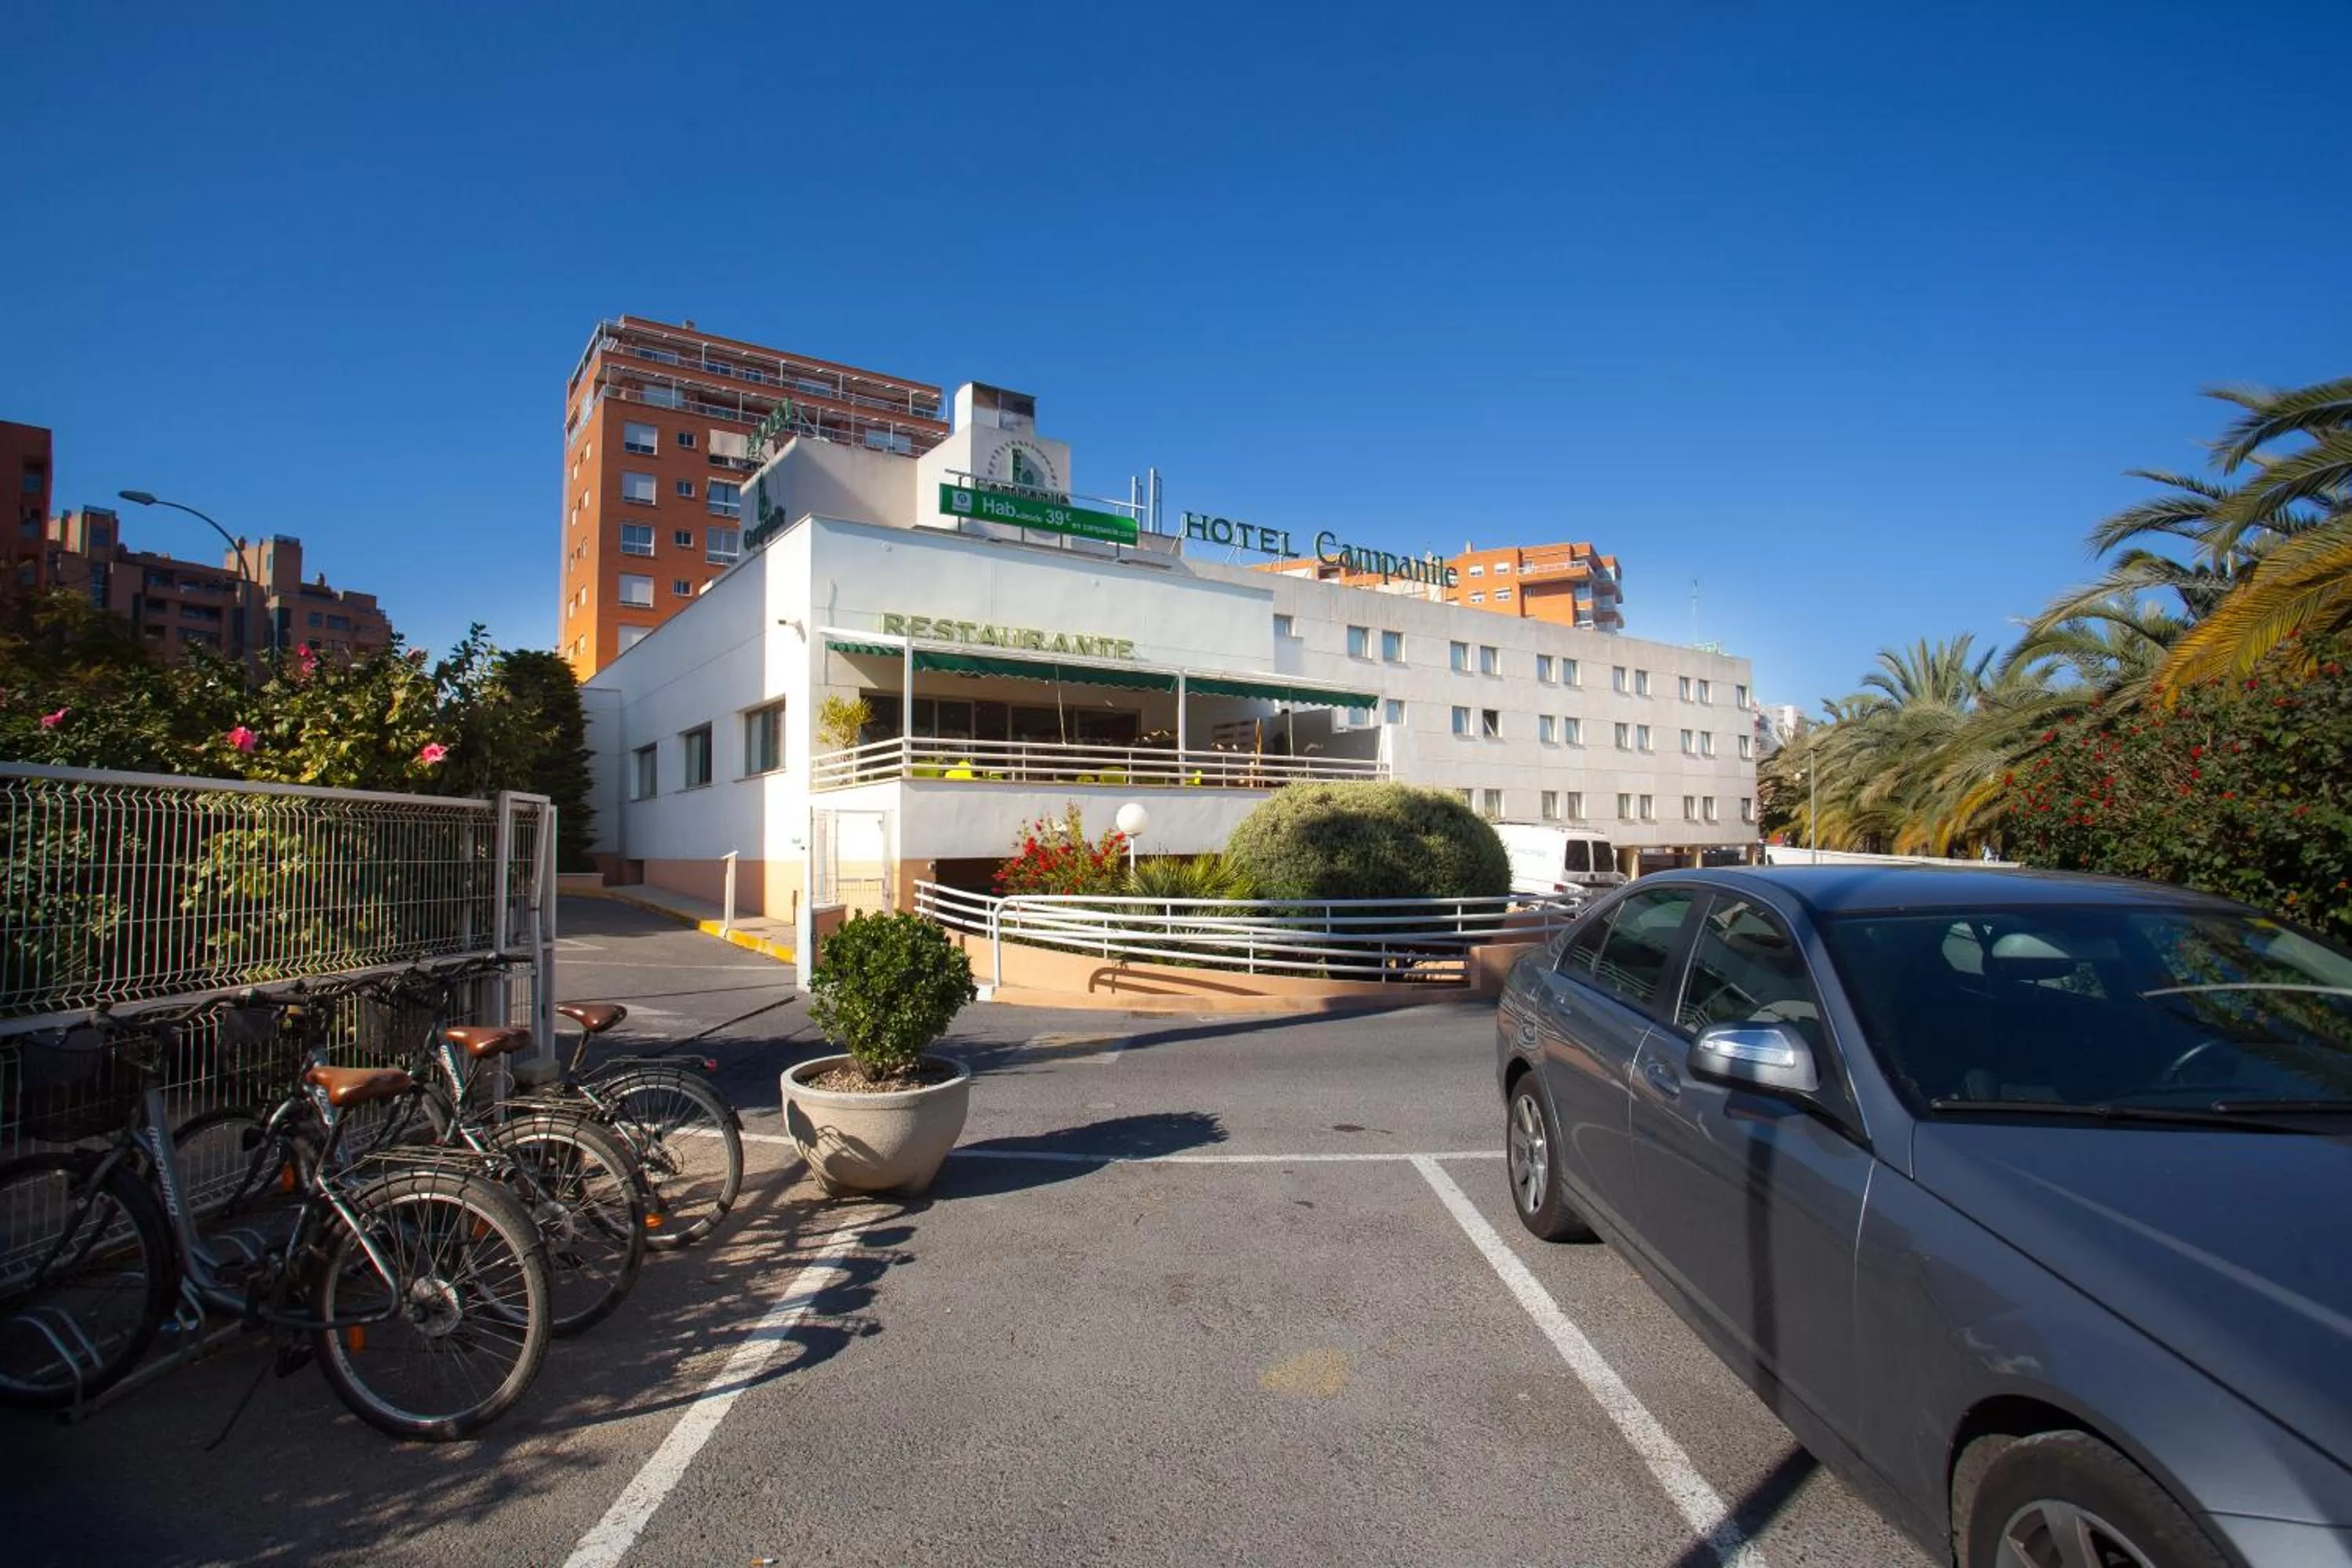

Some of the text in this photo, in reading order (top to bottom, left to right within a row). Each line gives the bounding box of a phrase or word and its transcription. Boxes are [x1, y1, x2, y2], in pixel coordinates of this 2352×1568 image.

[1183, 510, 1459, 589] HOTEL Campanile
[881, 612, 1135, 660] RESTAURANTE
